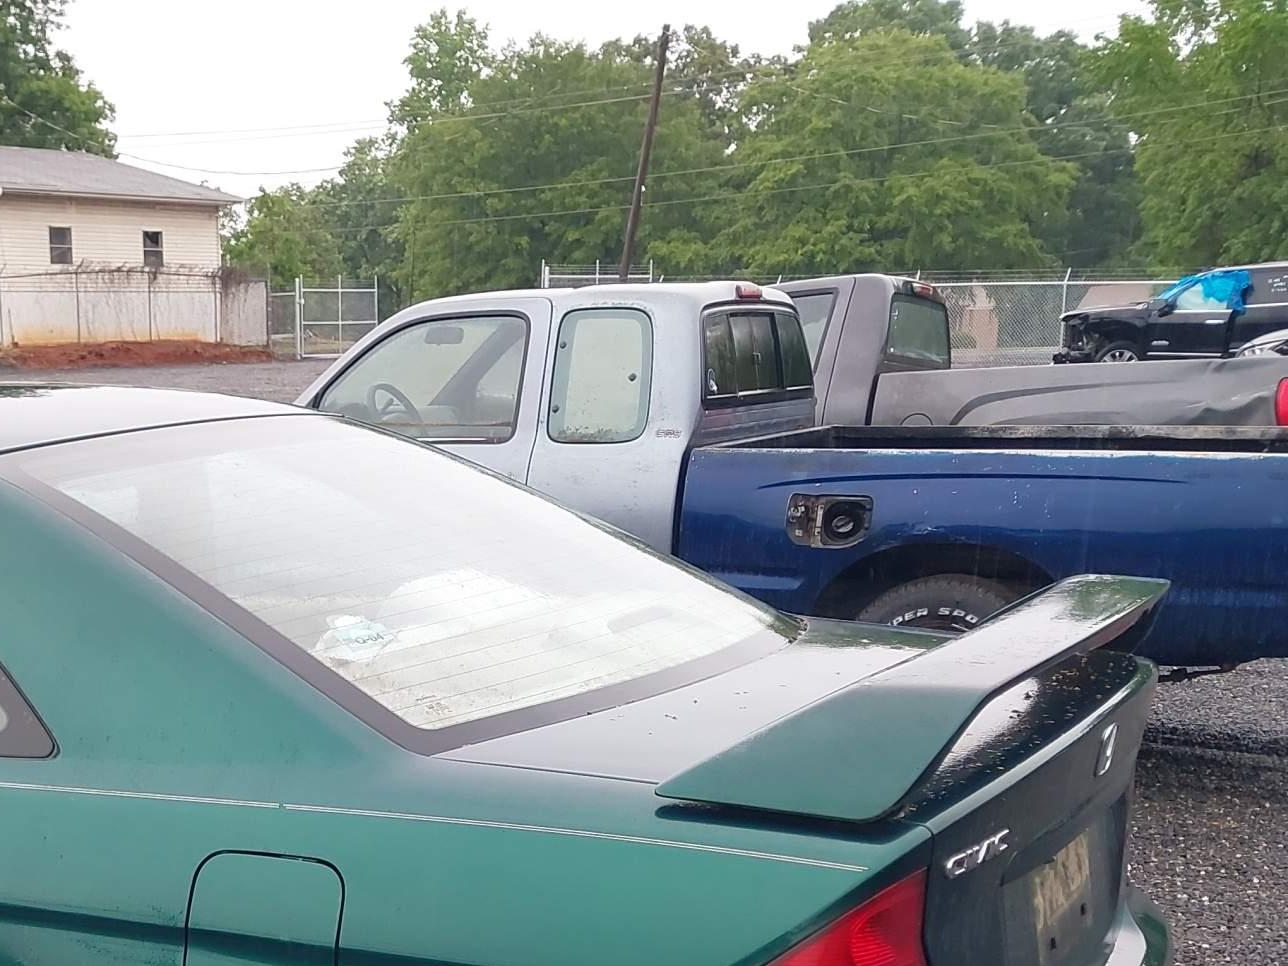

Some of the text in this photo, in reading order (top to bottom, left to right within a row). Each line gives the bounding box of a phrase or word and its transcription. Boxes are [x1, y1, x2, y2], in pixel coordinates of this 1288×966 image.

[886, 607, 980, 627] PER SPO
[944, 828, 1010, 879] CIVIC
